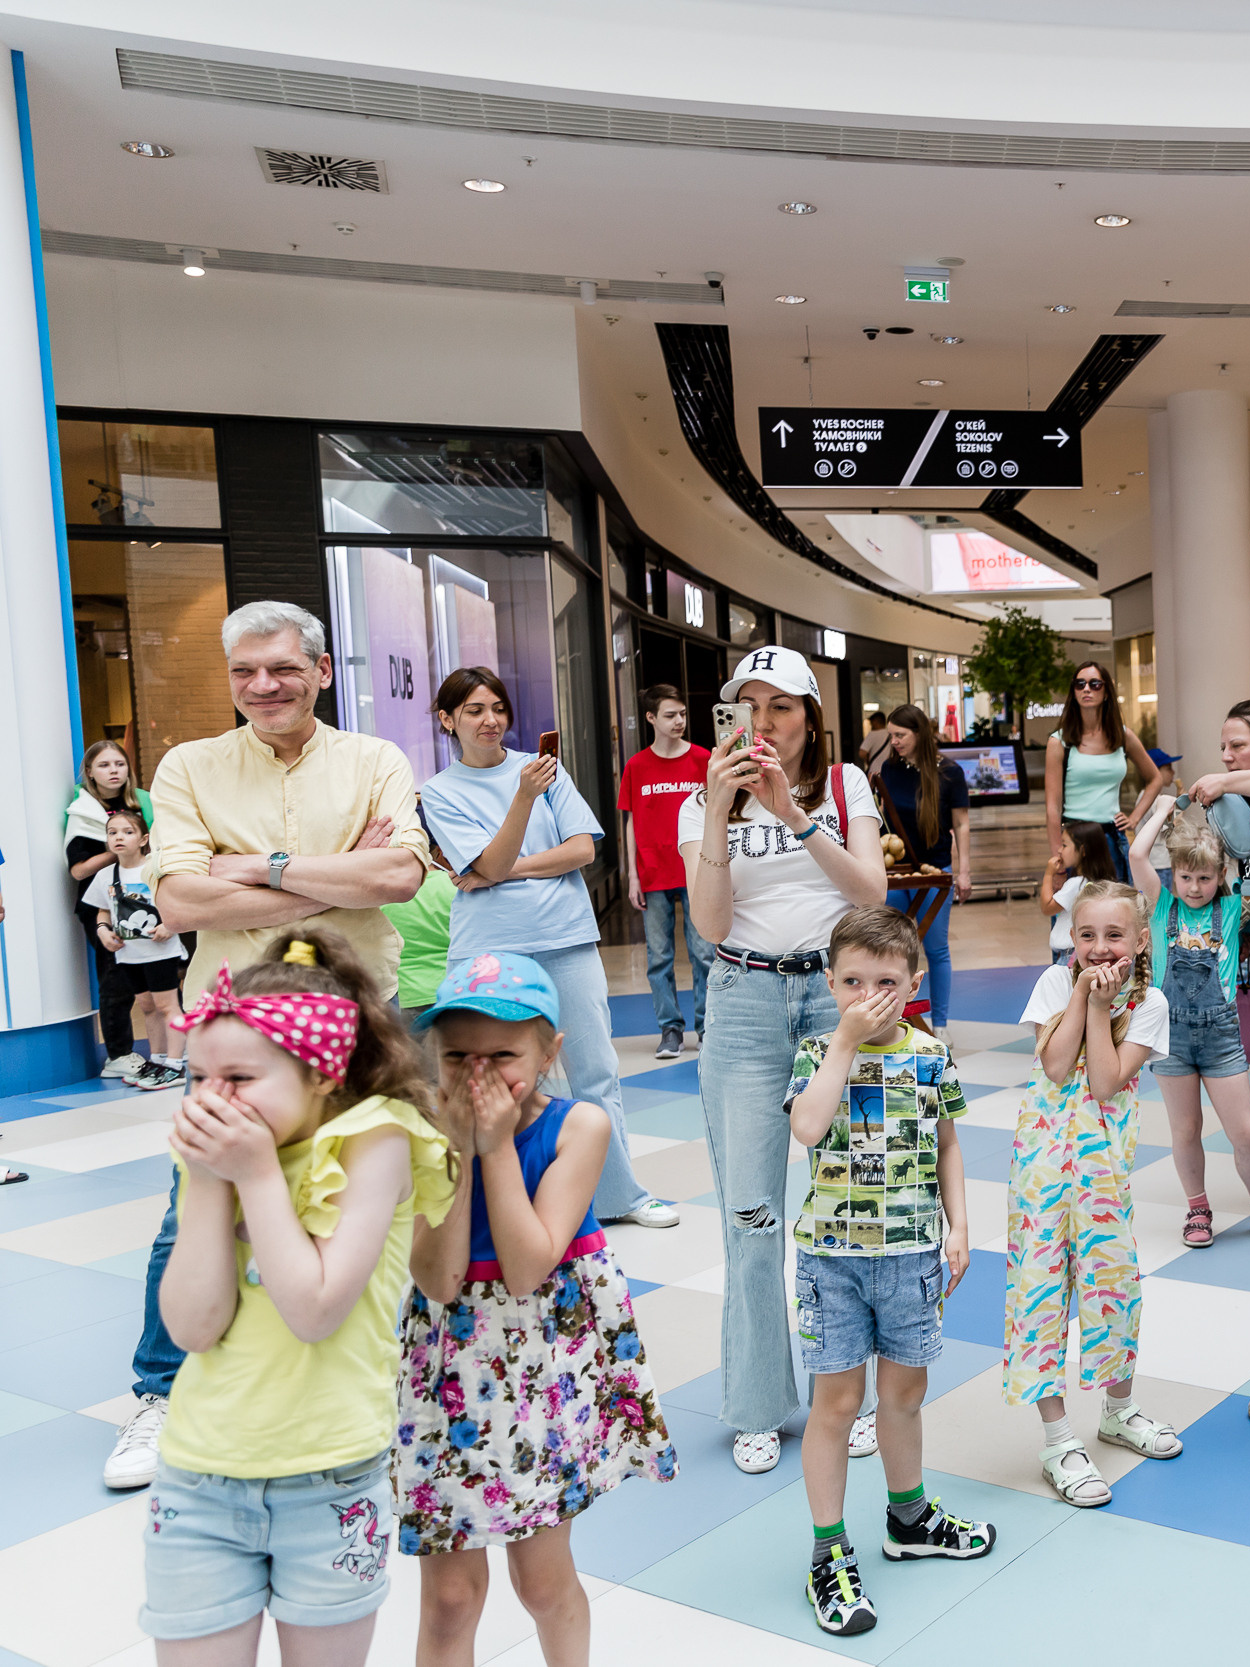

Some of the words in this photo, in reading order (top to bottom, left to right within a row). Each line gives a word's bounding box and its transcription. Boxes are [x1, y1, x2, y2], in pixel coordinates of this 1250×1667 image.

[812, 419, 839, 429] YVES
[841, 420, 884, 429] ROCHER
[813, 430, 882, 440] ХАМОВНИКИ
[955, 432, 1003, 442] SOKOLOV
[814, 442, 854, 452] ТУАЛЕТ
[955, 443, 993, 453] TEZENIS
[684, 583, 704, 628] DUB
[749, 651, 777, 672] H
[389, 654, 414, 700] DUB
